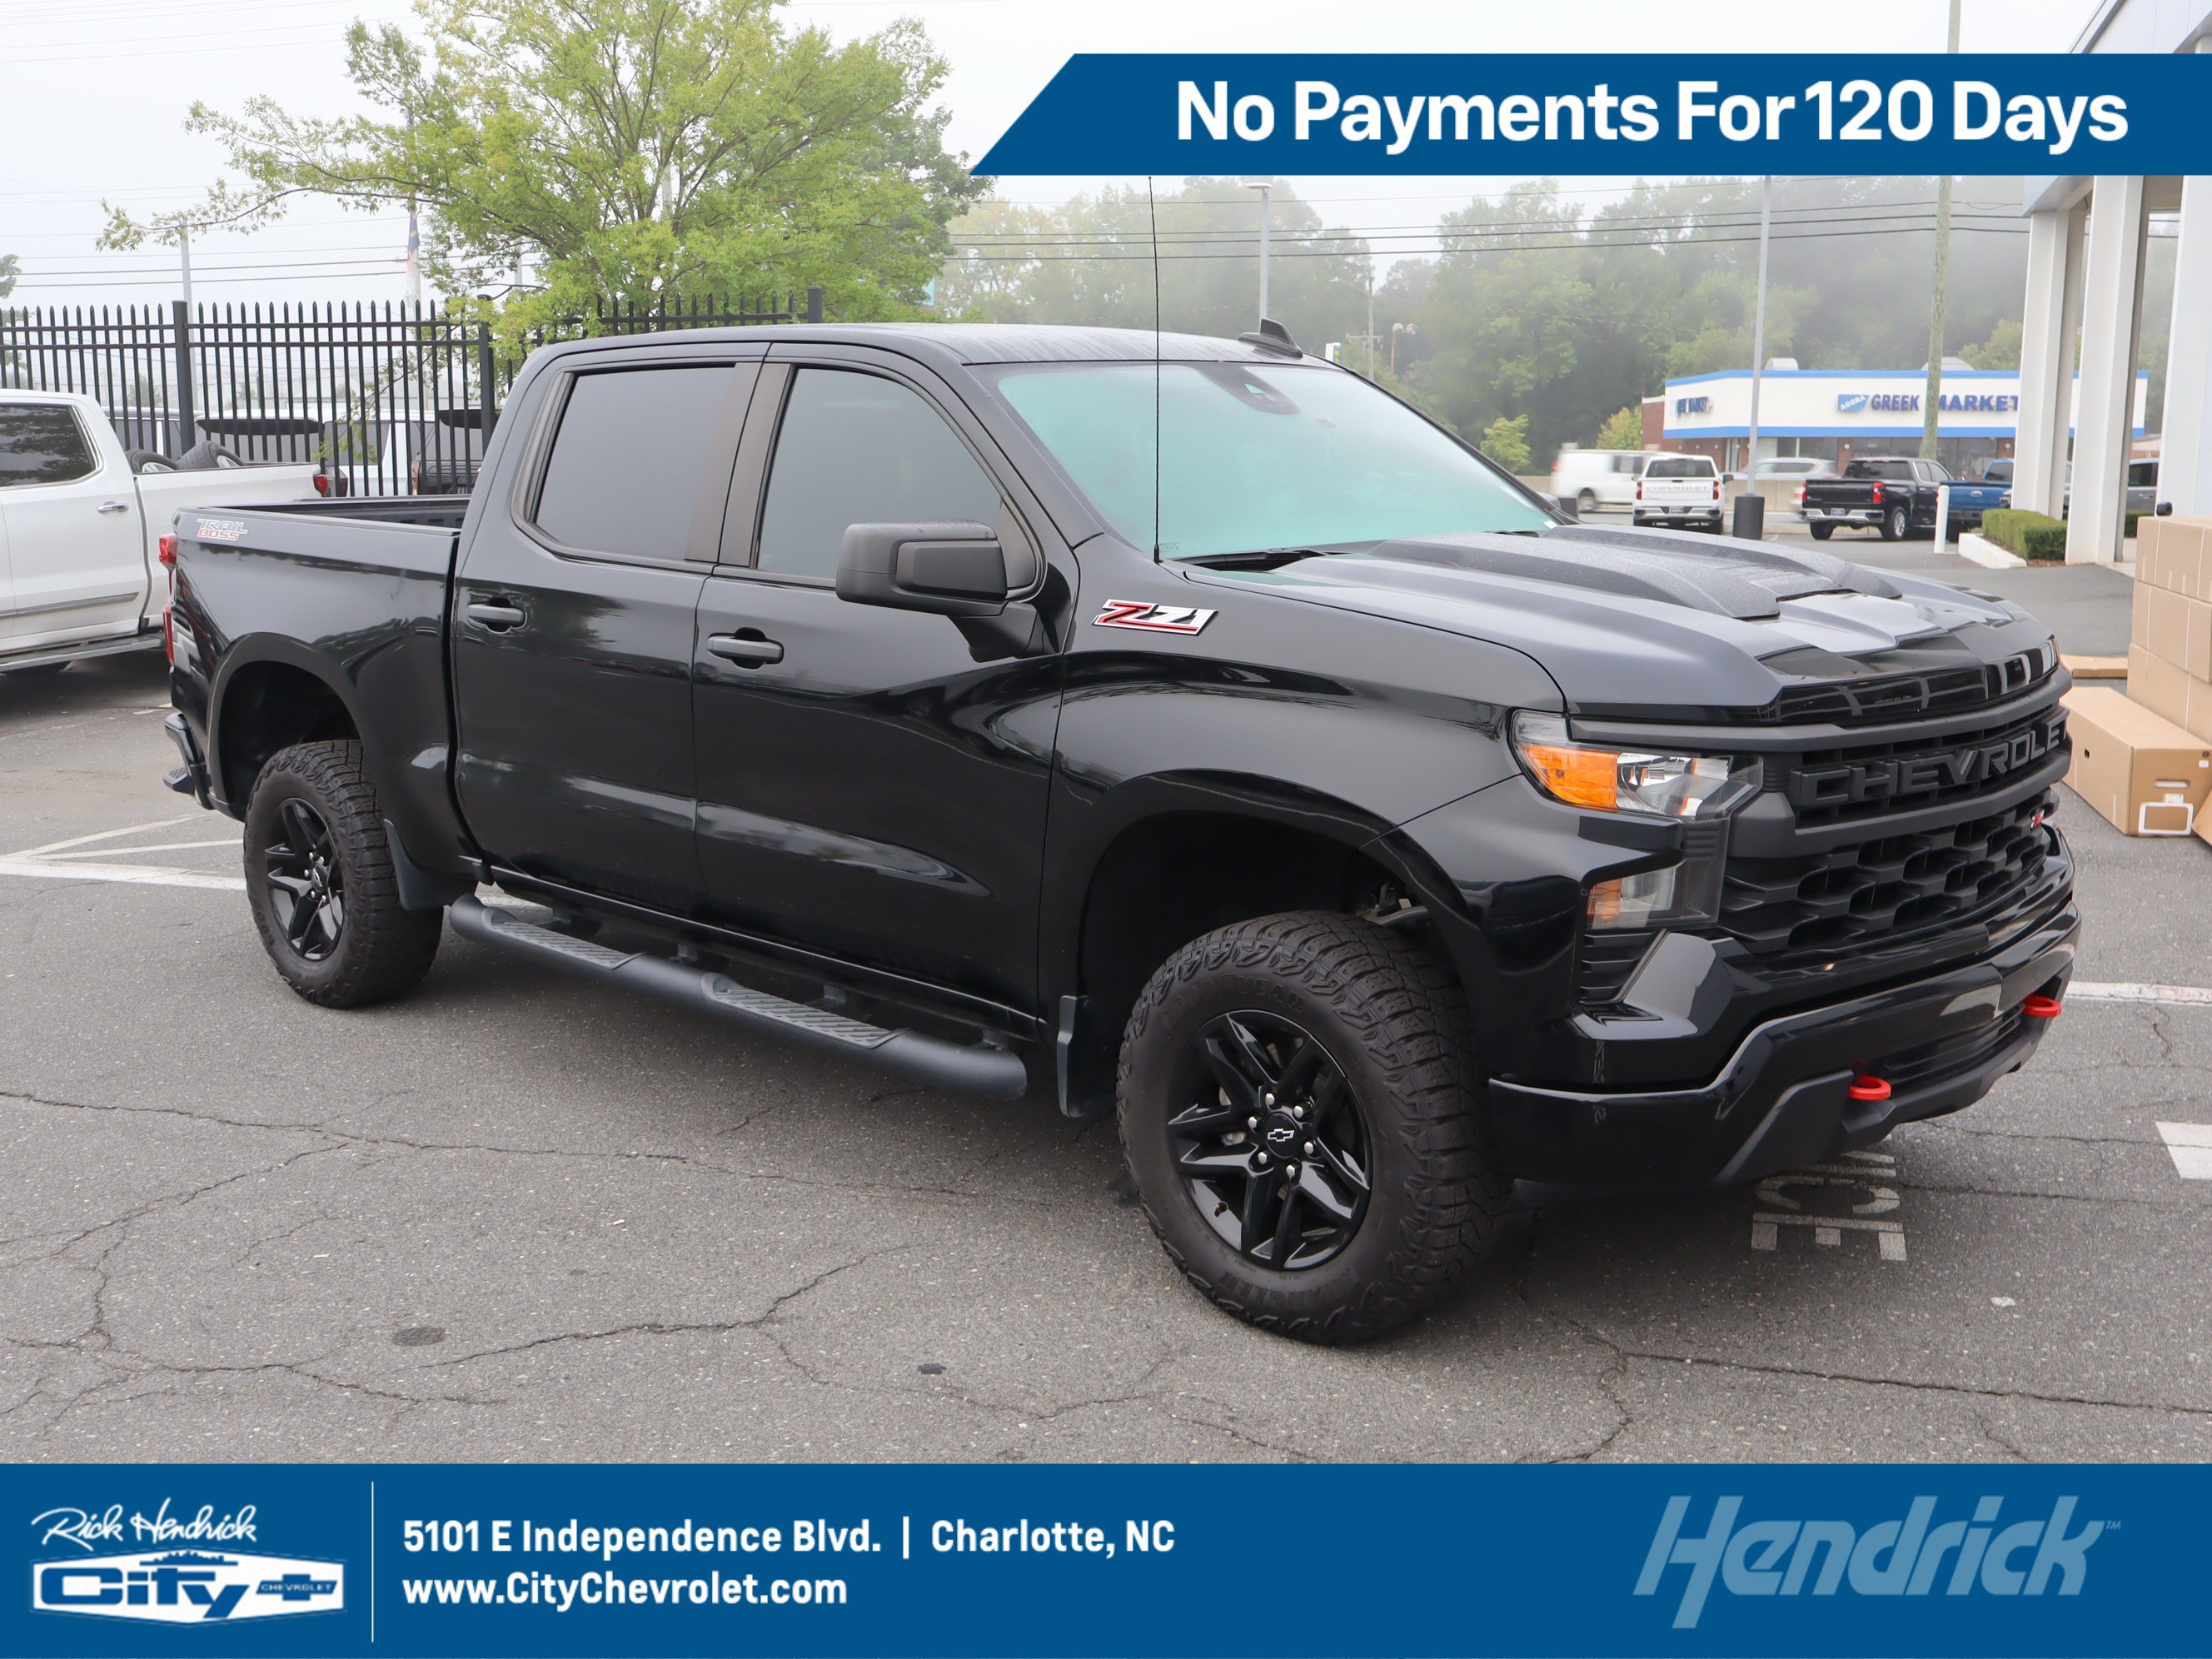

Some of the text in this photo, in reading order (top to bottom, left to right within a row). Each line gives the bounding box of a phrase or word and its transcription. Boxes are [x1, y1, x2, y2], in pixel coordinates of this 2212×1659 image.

[1840, 395, 1866, 411] AGORA
[1871, 394, 1920, 412] GREEK
[197, 518, 248, 535] TRAIL
[197, 529, 241, 541] BOSS
[1092, 599, 1218, 635] Z71
